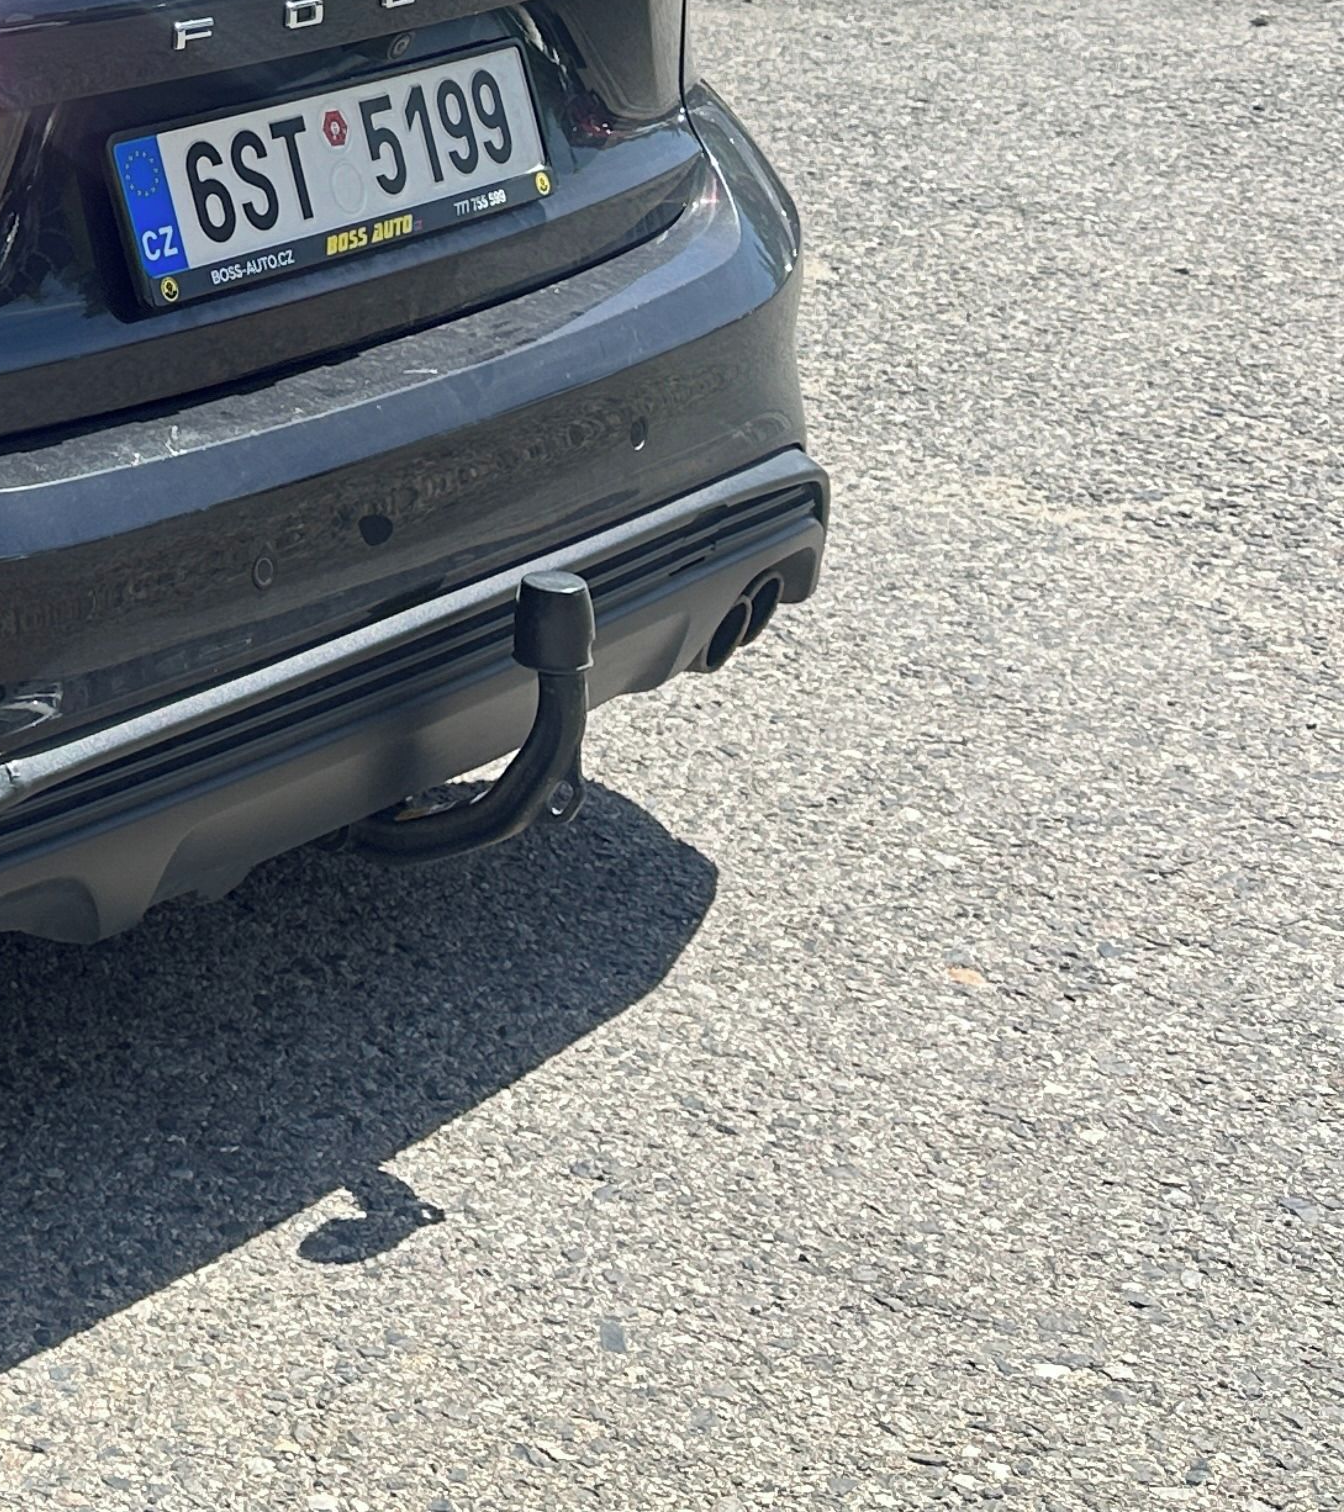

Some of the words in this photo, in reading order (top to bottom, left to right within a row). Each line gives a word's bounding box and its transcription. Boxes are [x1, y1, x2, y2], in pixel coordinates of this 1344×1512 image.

[185, 115, 314, 244] 6ST
[359, 70, 513, 196] 5199
[141, 225, 179, 262] CZ
[327, 226, 368, 256] BOSS
[371, 214, 413, 243] AUTO
[210, 249, 296, 285] BOSS-AUTO.CZ
